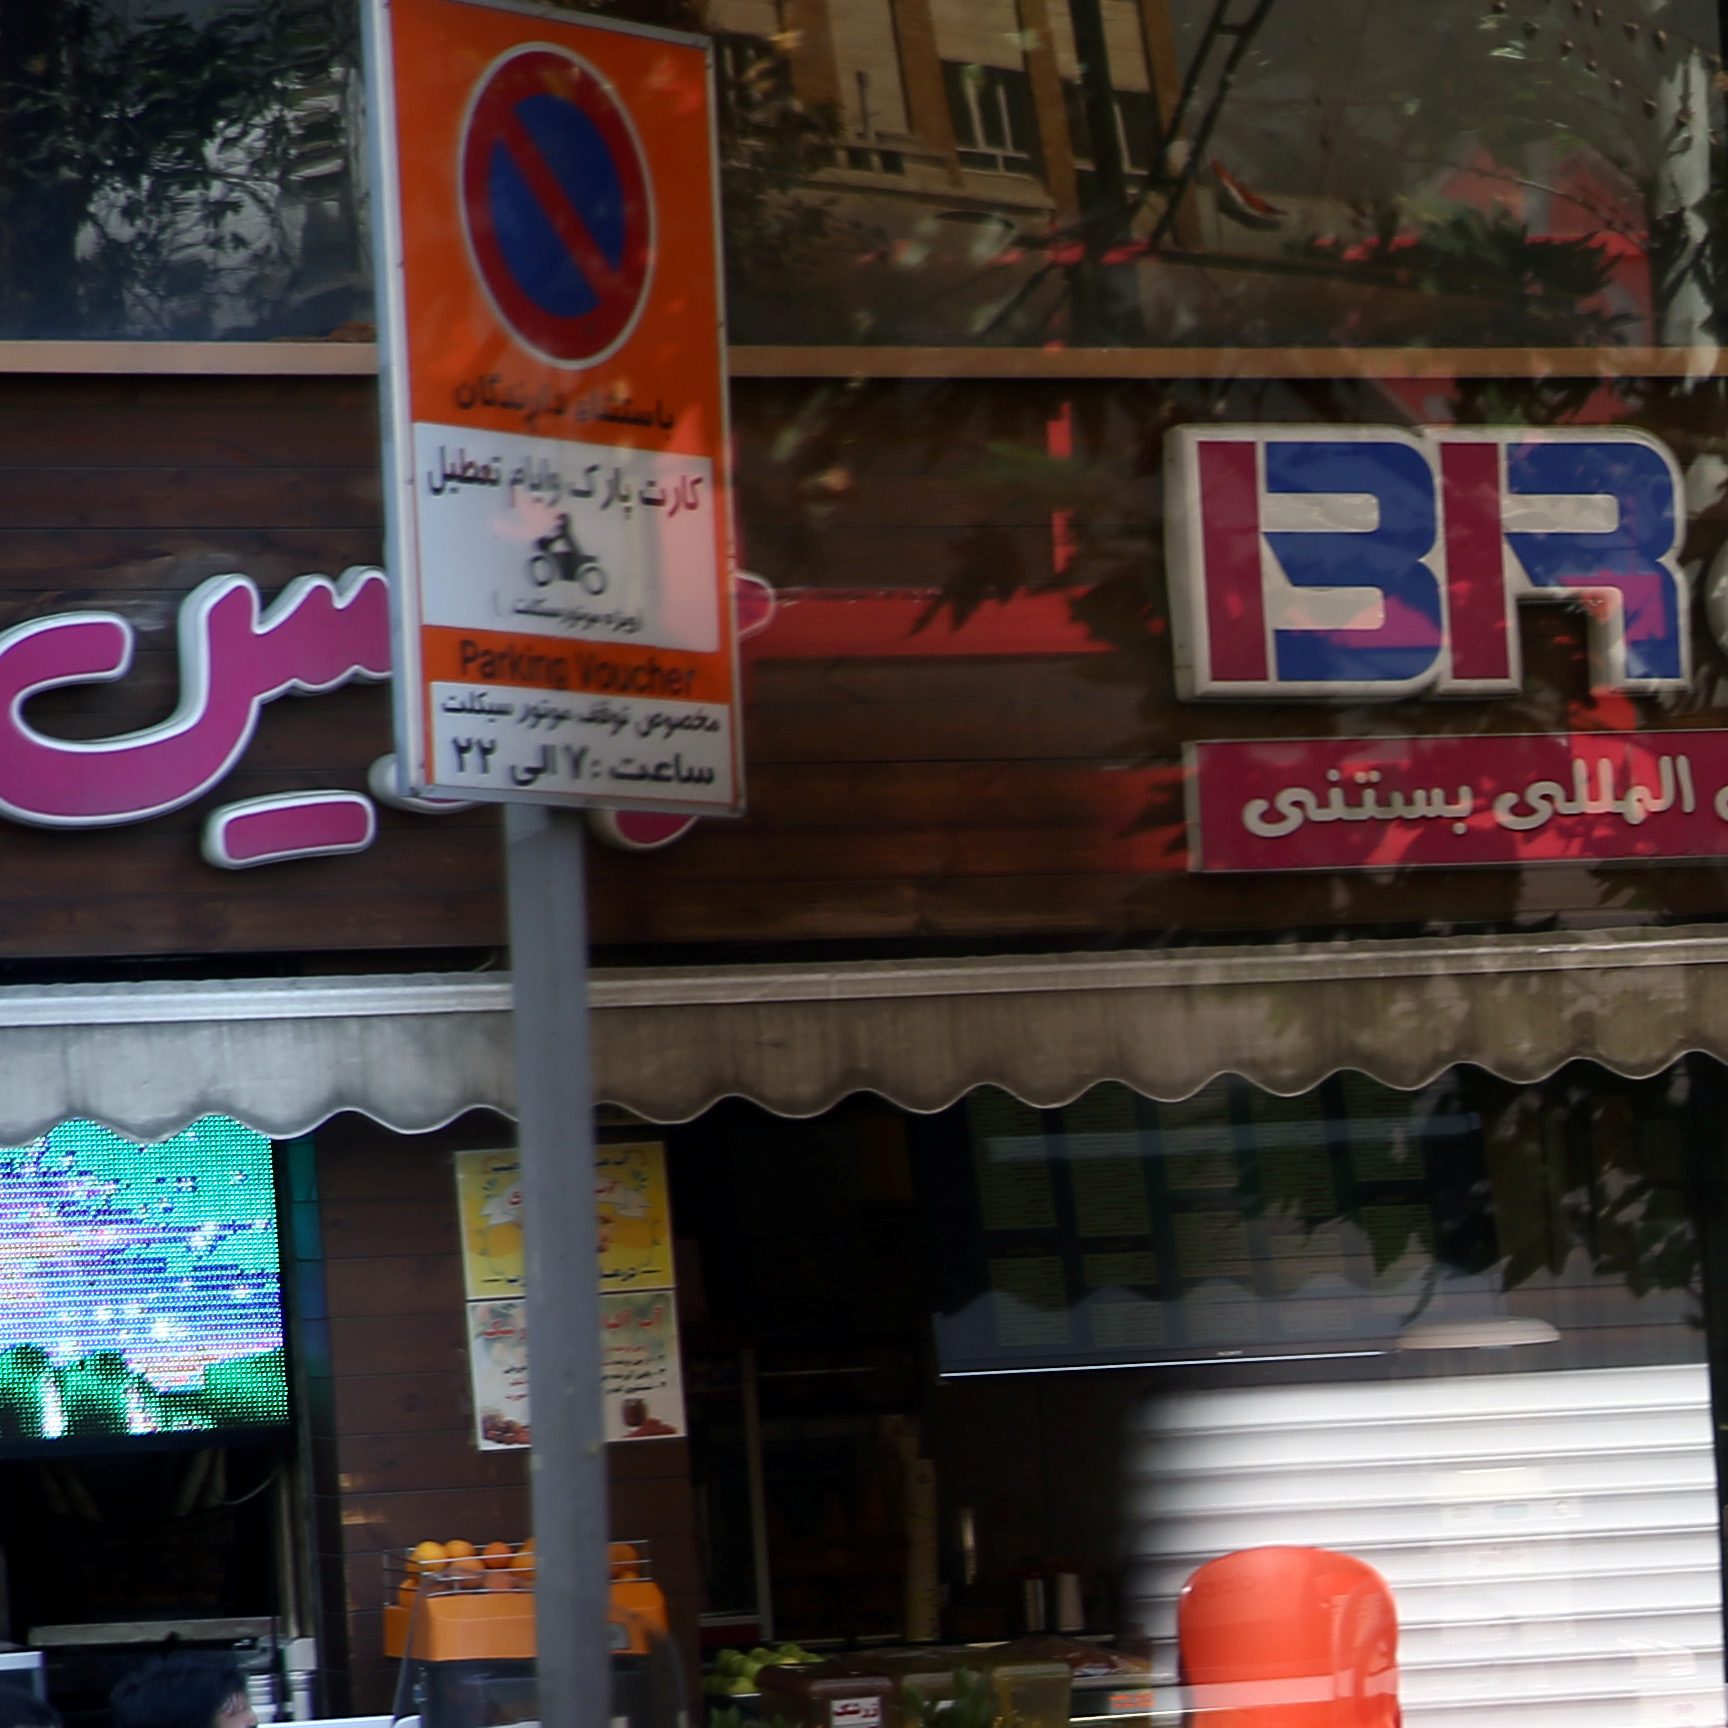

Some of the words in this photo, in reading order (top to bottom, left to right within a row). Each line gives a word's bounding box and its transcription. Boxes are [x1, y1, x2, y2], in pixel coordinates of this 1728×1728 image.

[427, 446, 500, 497] تعطیل
[640, 474, 705, 518] کارت
[1168, 424, 1692, 702] BR
[459, 638, 570, 692] Parking
[578, 652, 697, 699] Voucher
[451, 733, 497, 776] ۲۲
[508, 741, 558, 789] الی
[608, 751, 716, 787] ساعت
[1240, 768, 1475, 840] بستنی
[1493, 752, 1693, 832] المللی
